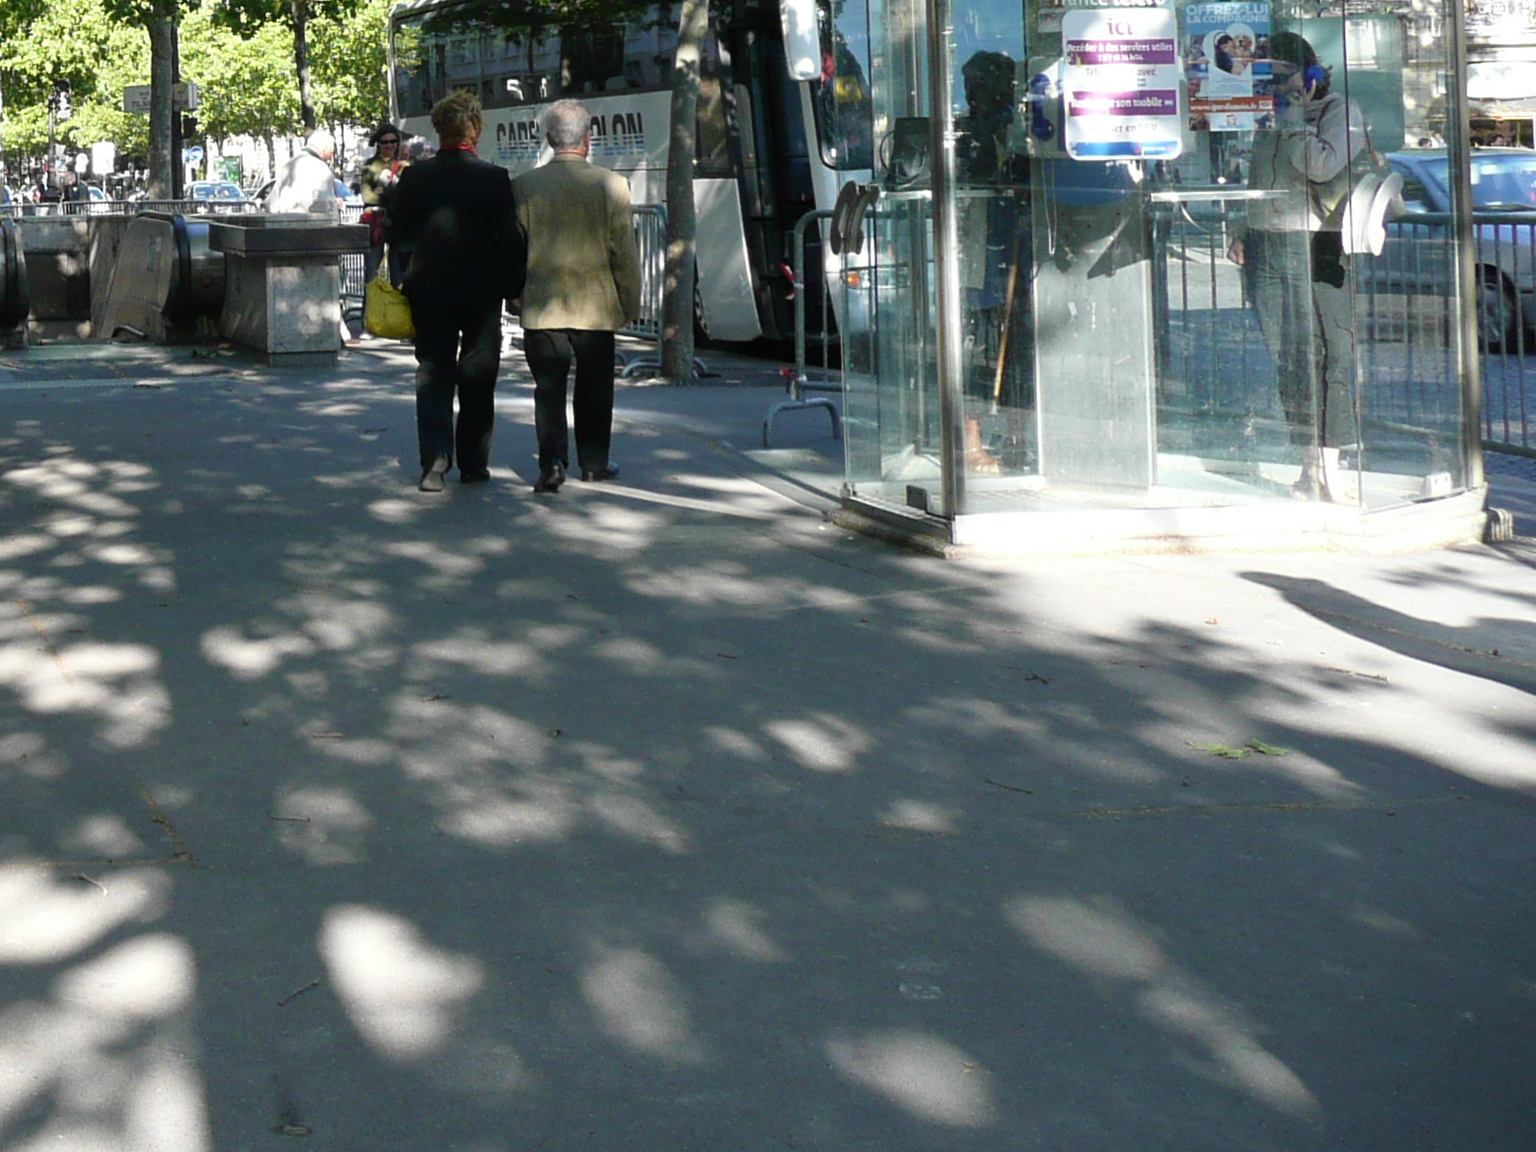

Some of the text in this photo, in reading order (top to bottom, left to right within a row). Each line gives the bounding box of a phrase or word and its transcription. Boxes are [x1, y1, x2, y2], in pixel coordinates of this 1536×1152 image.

[1186, 4, 1269, 16] OFFREZ-LUI
[1187, 14, 1269, 24] LA COMPAGNIE
[1133, 97, 1163, 107] mobile
